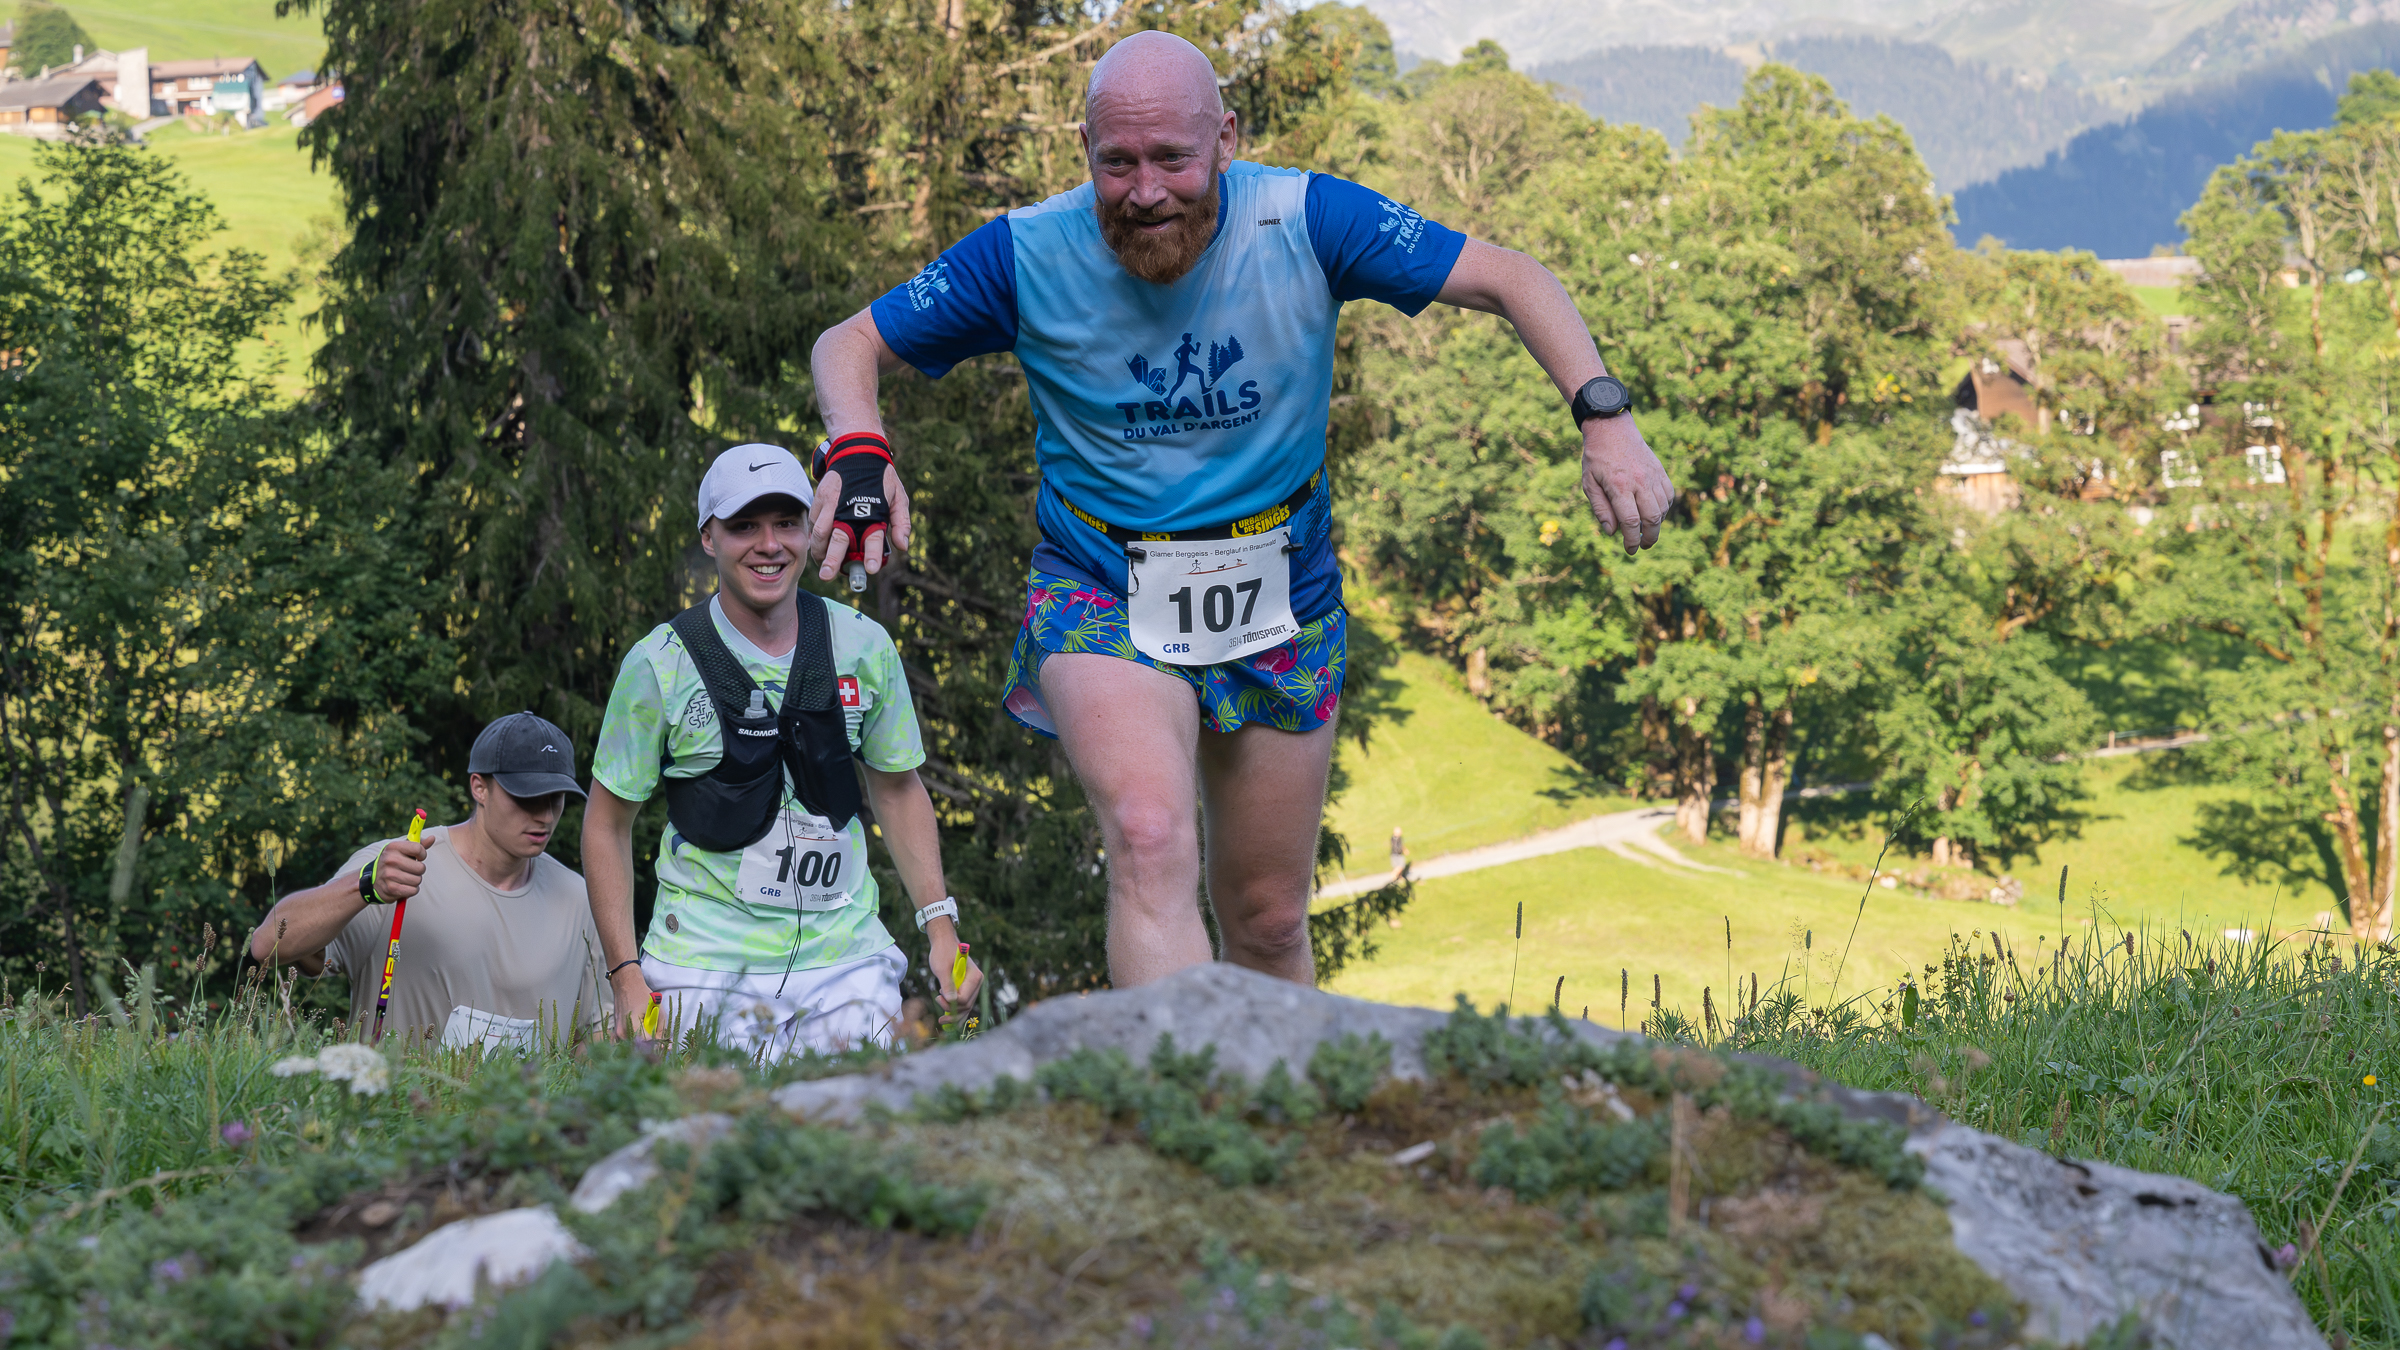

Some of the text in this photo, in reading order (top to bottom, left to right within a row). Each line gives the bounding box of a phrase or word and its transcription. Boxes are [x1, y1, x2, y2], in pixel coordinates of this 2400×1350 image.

[1407, 243, 1416, 254] DU
[1115, 380, 1262, 424] TRAILS
[1123, 409, 1261, 440] DU VAL D'ARGENT
[1244, 505, 1290, 534] DES SINGES
[1215, 547, 1241, 556] Berglauf
[1168, 577, 1263, 634] 107
[1162, 643, 1191, 654] GRB
[737, 728, 779, 737] SALOMON
[775, 845, 842, 888] 100
[760, 886, 782, 898] GRB
